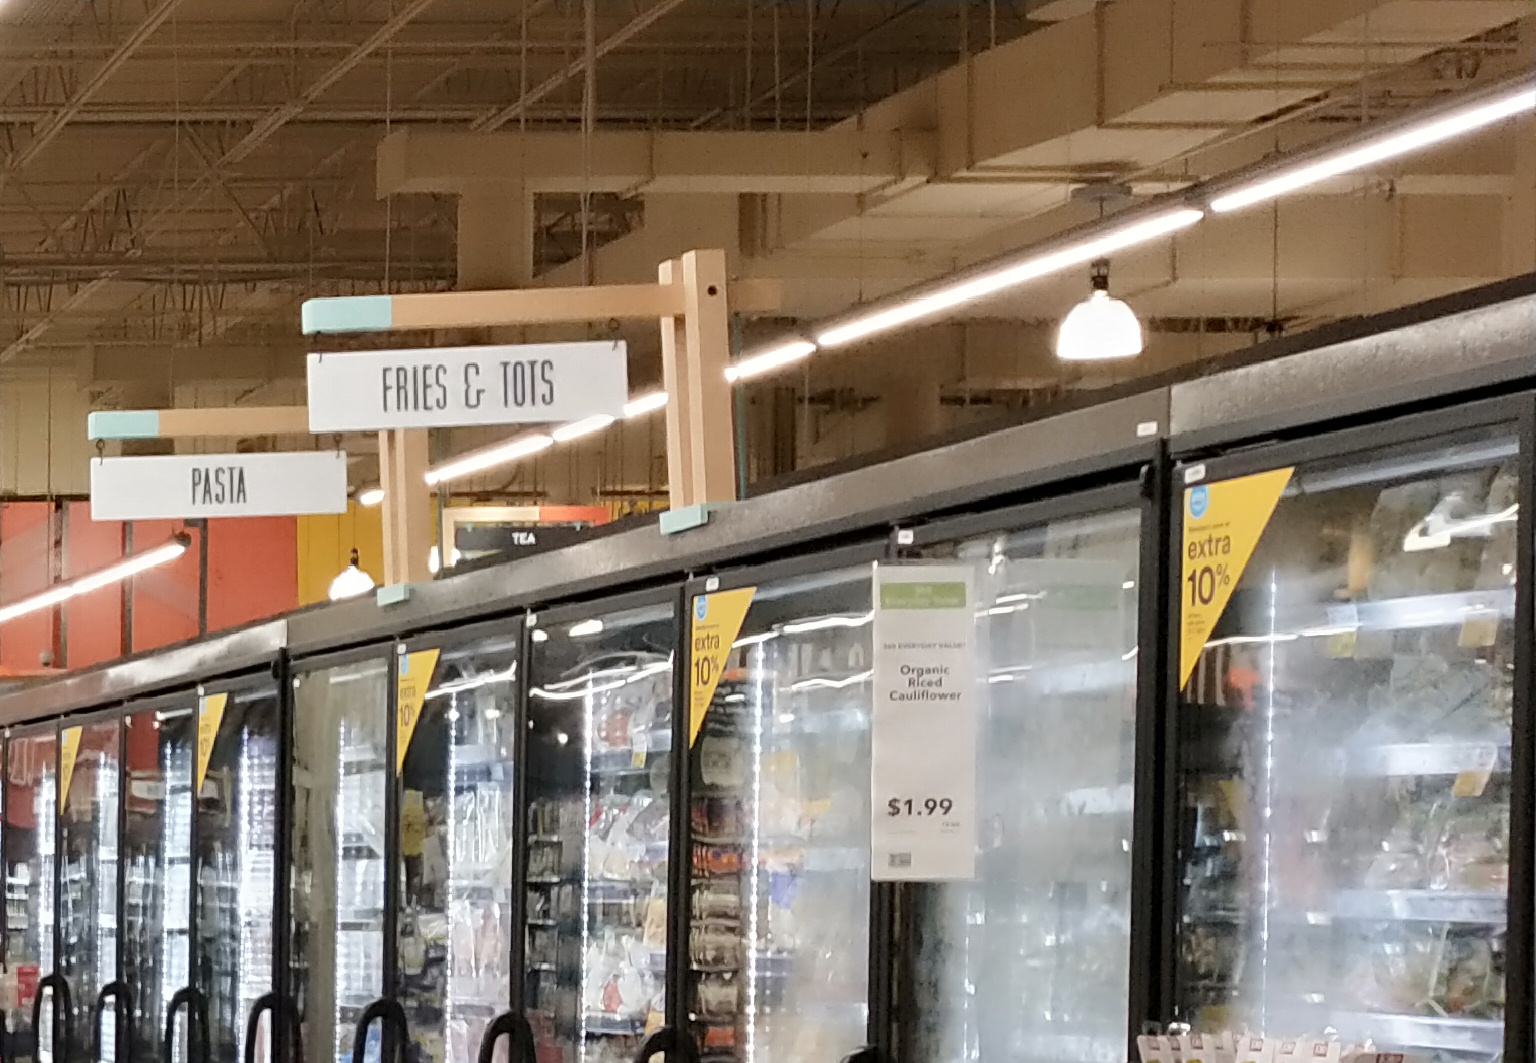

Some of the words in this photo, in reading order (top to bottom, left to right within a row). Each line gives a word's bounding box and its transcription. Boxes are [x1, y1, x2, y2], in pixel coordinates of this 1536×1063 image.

[382, 364, 447, 412] FRIES
[464, 362, 485, 409] &
[499, 360, 555, 408] TOTS
[191, 467, 248, 505] PASTA
[512, 533, 536, 545] TEA
[1187, 534, 1231, 560] extra
[1187, 562, 1231, 607] 10%
[694, 632, 720, 651] extra
[694, 655, 719, 687] 10%
[900, 664, 950, 681] Organic
[908, 677, 943, 688] Riced
[889, 689, 962, 702] Cauliflower
[887, 797, 953, 816] $1.99
